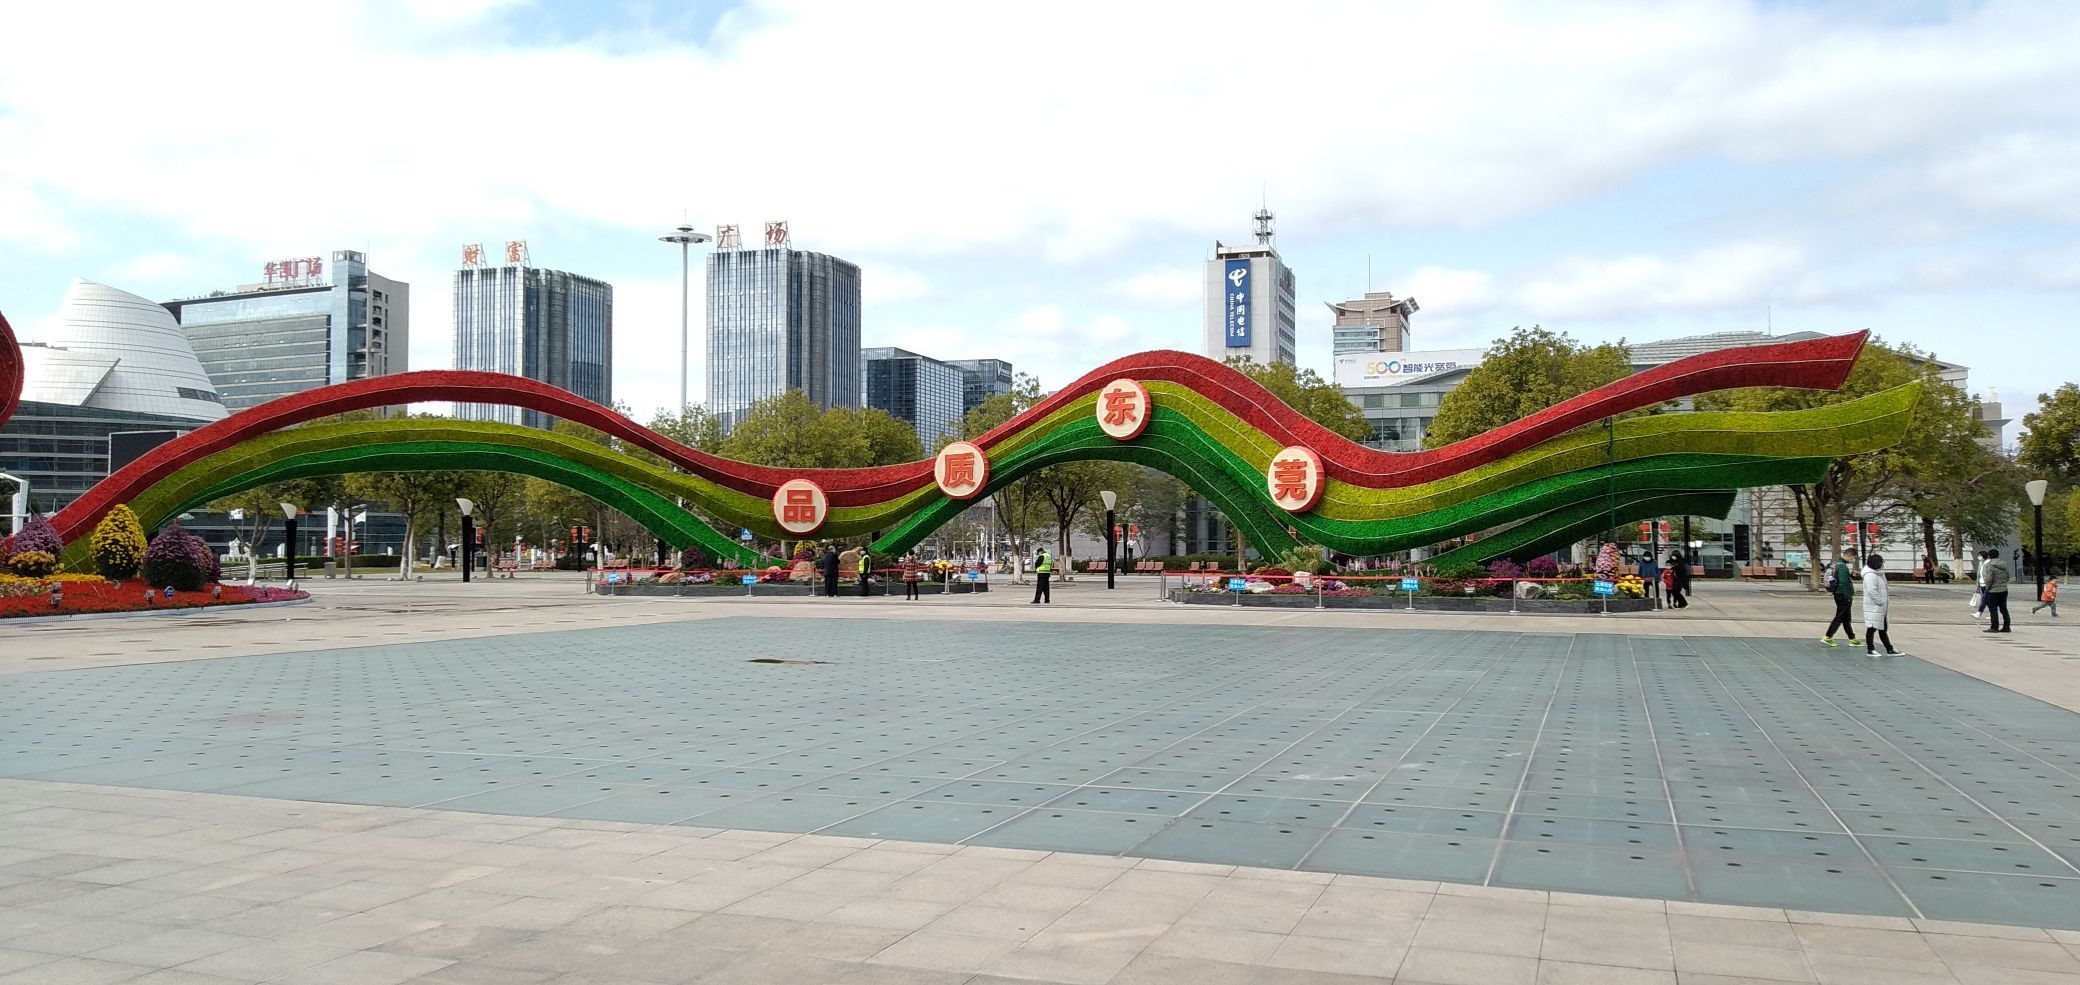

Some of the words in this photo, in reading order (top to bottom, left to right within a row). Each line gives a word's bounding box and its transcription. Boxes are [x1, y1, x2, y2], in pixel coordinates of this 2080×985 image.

[1236, 292, 1245, 337] 中国电信
[784, 490, 816, 523] 品
[943, 452, 975, 488] 质
[1104, 388, 1136, 425] 东
[1274, 459, 1308, 501] 莞
